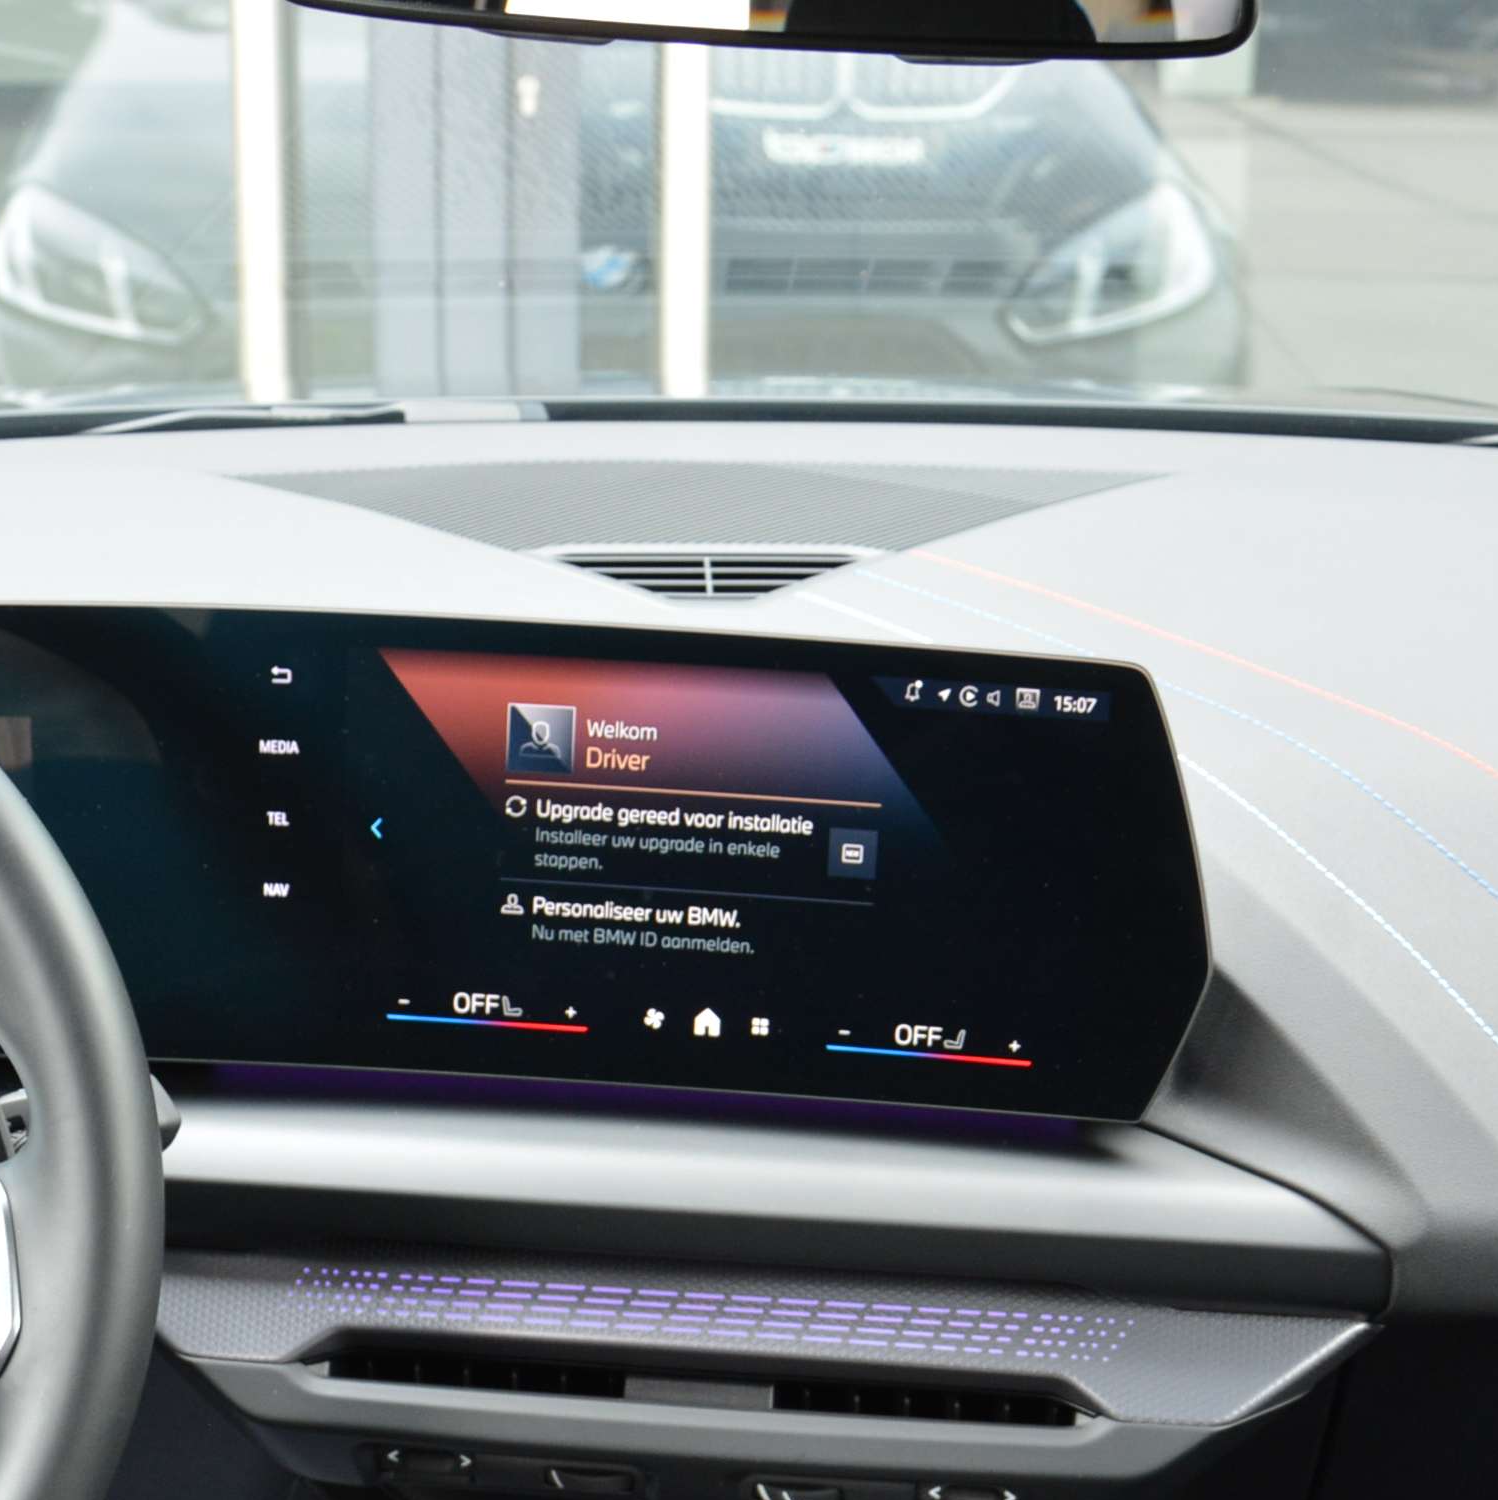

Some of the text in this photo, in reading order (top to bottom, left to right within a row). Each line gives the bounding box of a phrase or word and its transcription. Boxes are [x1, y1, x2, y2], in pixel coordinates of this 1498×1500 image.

[1053, 695, 1098, 714] 15:07
[586, 718, 658, 741] Welkom
[259, 739, 300, 755] MEDIA
[585, 746, 650, 771] Driver
[266, 810, 290, 826] TEL
[535, 798, 814, 836] Upgrade gereed voor installatie
[535, 827, 781, 859] Installeer uw upgrade in enkele
[534, 853, 603, 871] stappen.
[263, 881, 290, 897] NAV
[532, 895, 741, 929] Personaliseer uw BMW.
[532, 924, 756, 955] Nu met BMW ID aanmelden.
[453, 991, 501, 1015] OFF
[894, 1023, 944, 1047] OFF
